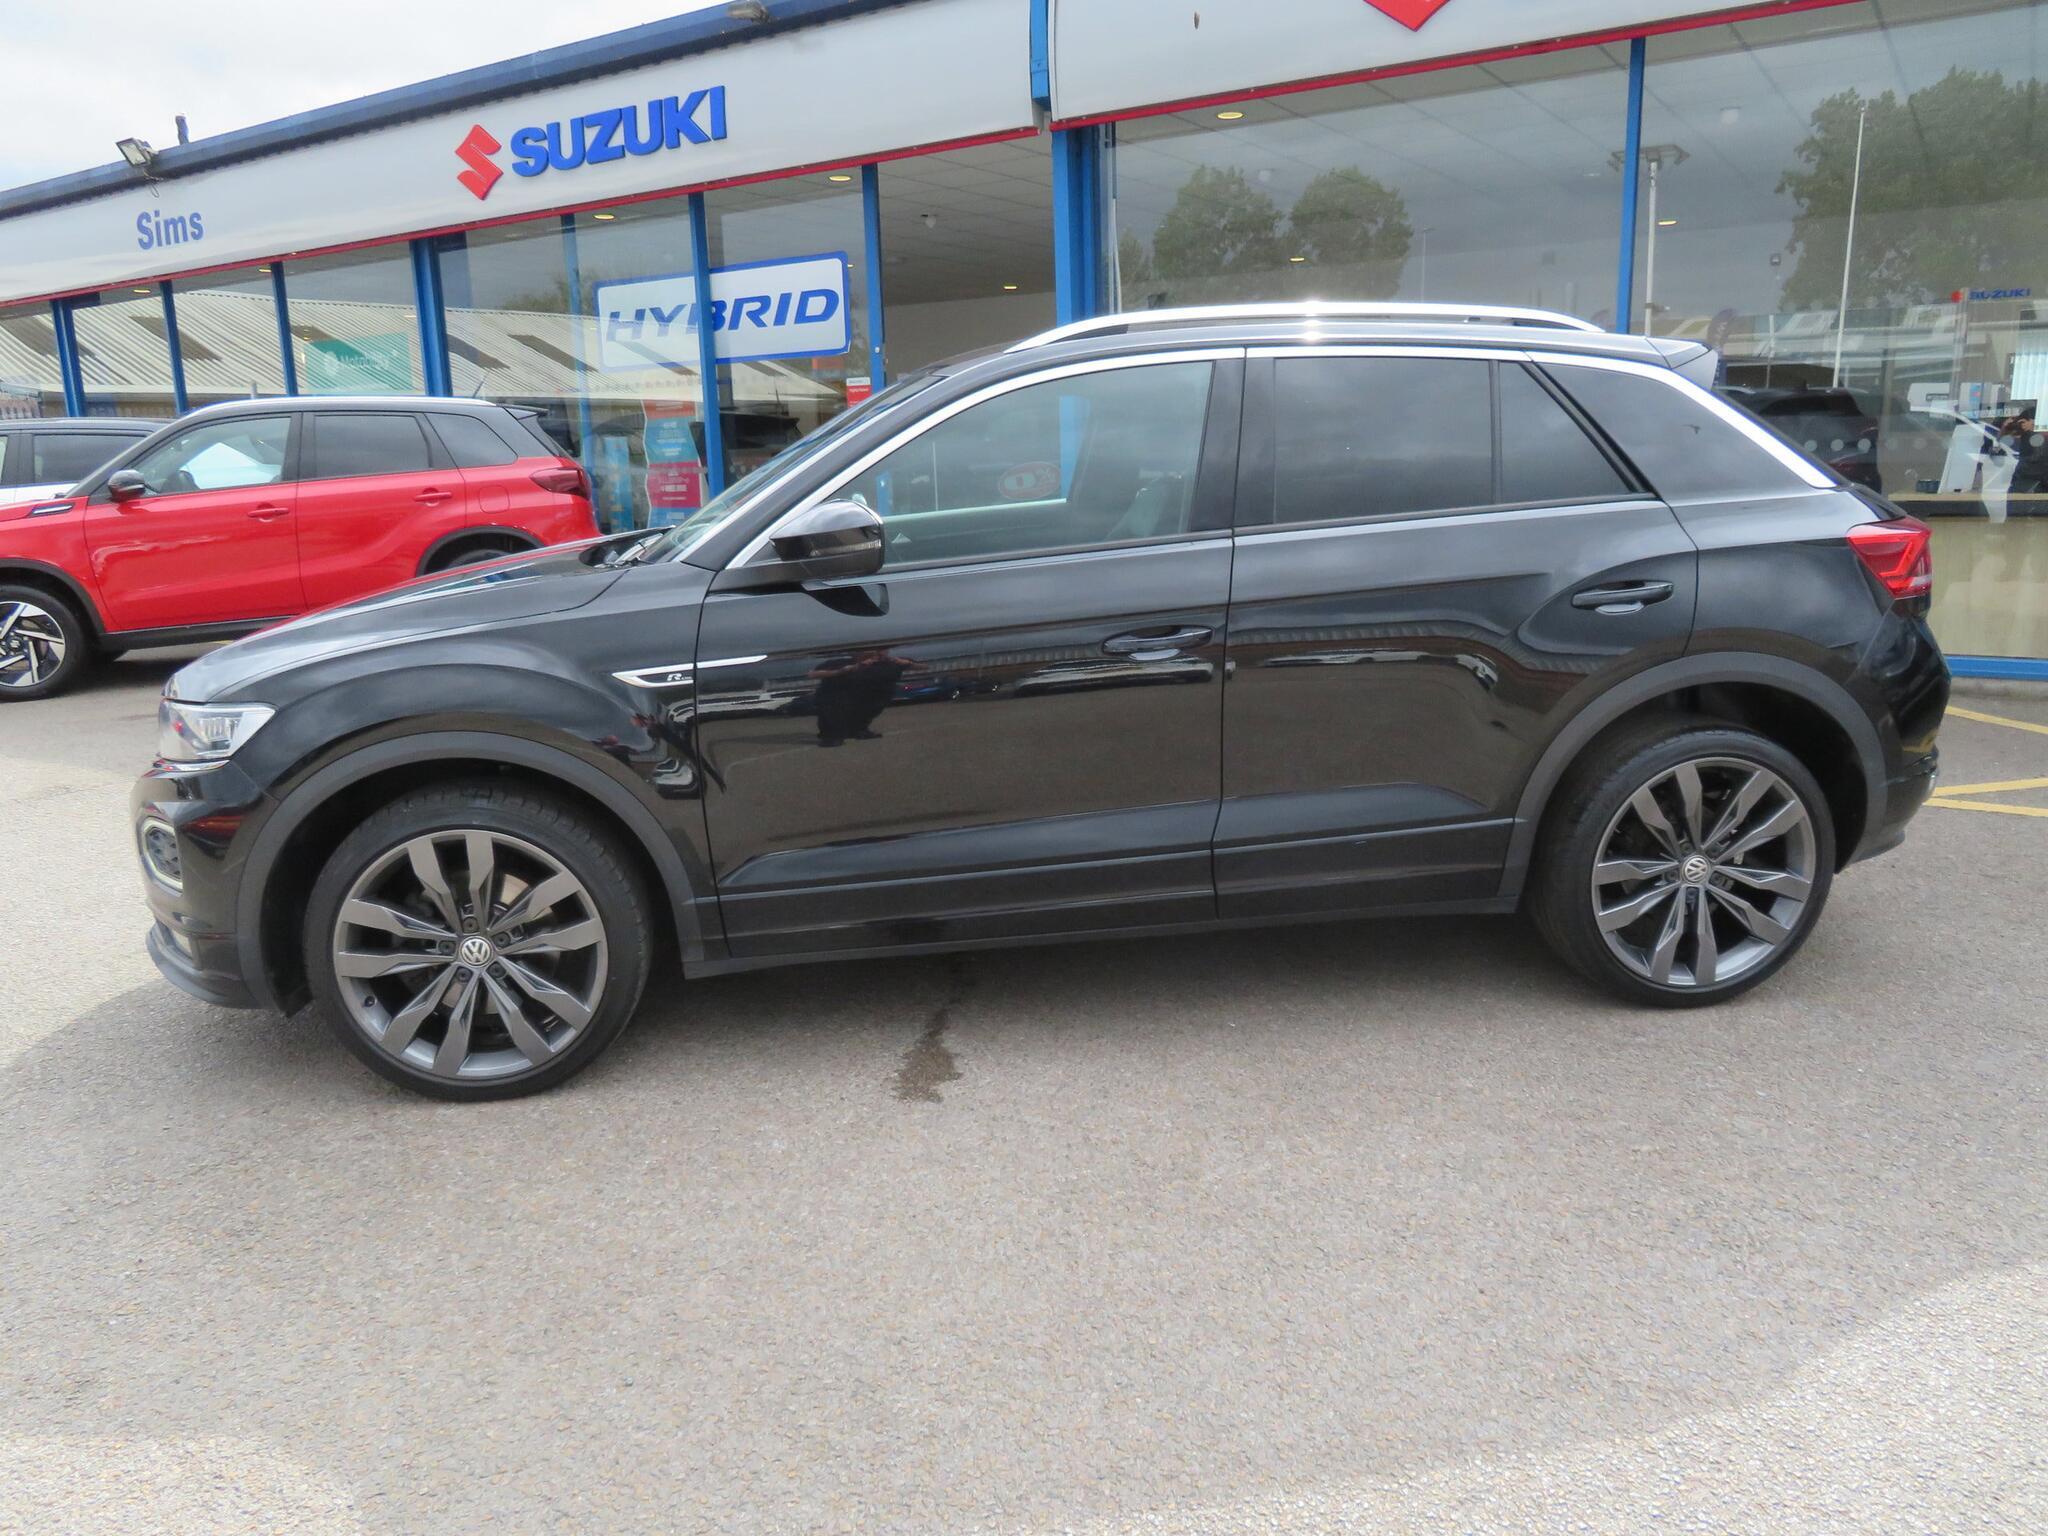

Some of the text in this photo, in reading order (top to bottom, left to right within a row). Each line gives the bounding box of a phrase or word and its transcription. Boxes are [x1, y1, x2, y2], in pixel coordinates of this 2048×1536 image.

[510, 85, 728, 178] SUZUKI
[136, 209, 204, 250] Sims
[606, 288, 840, 342] HYBRID
